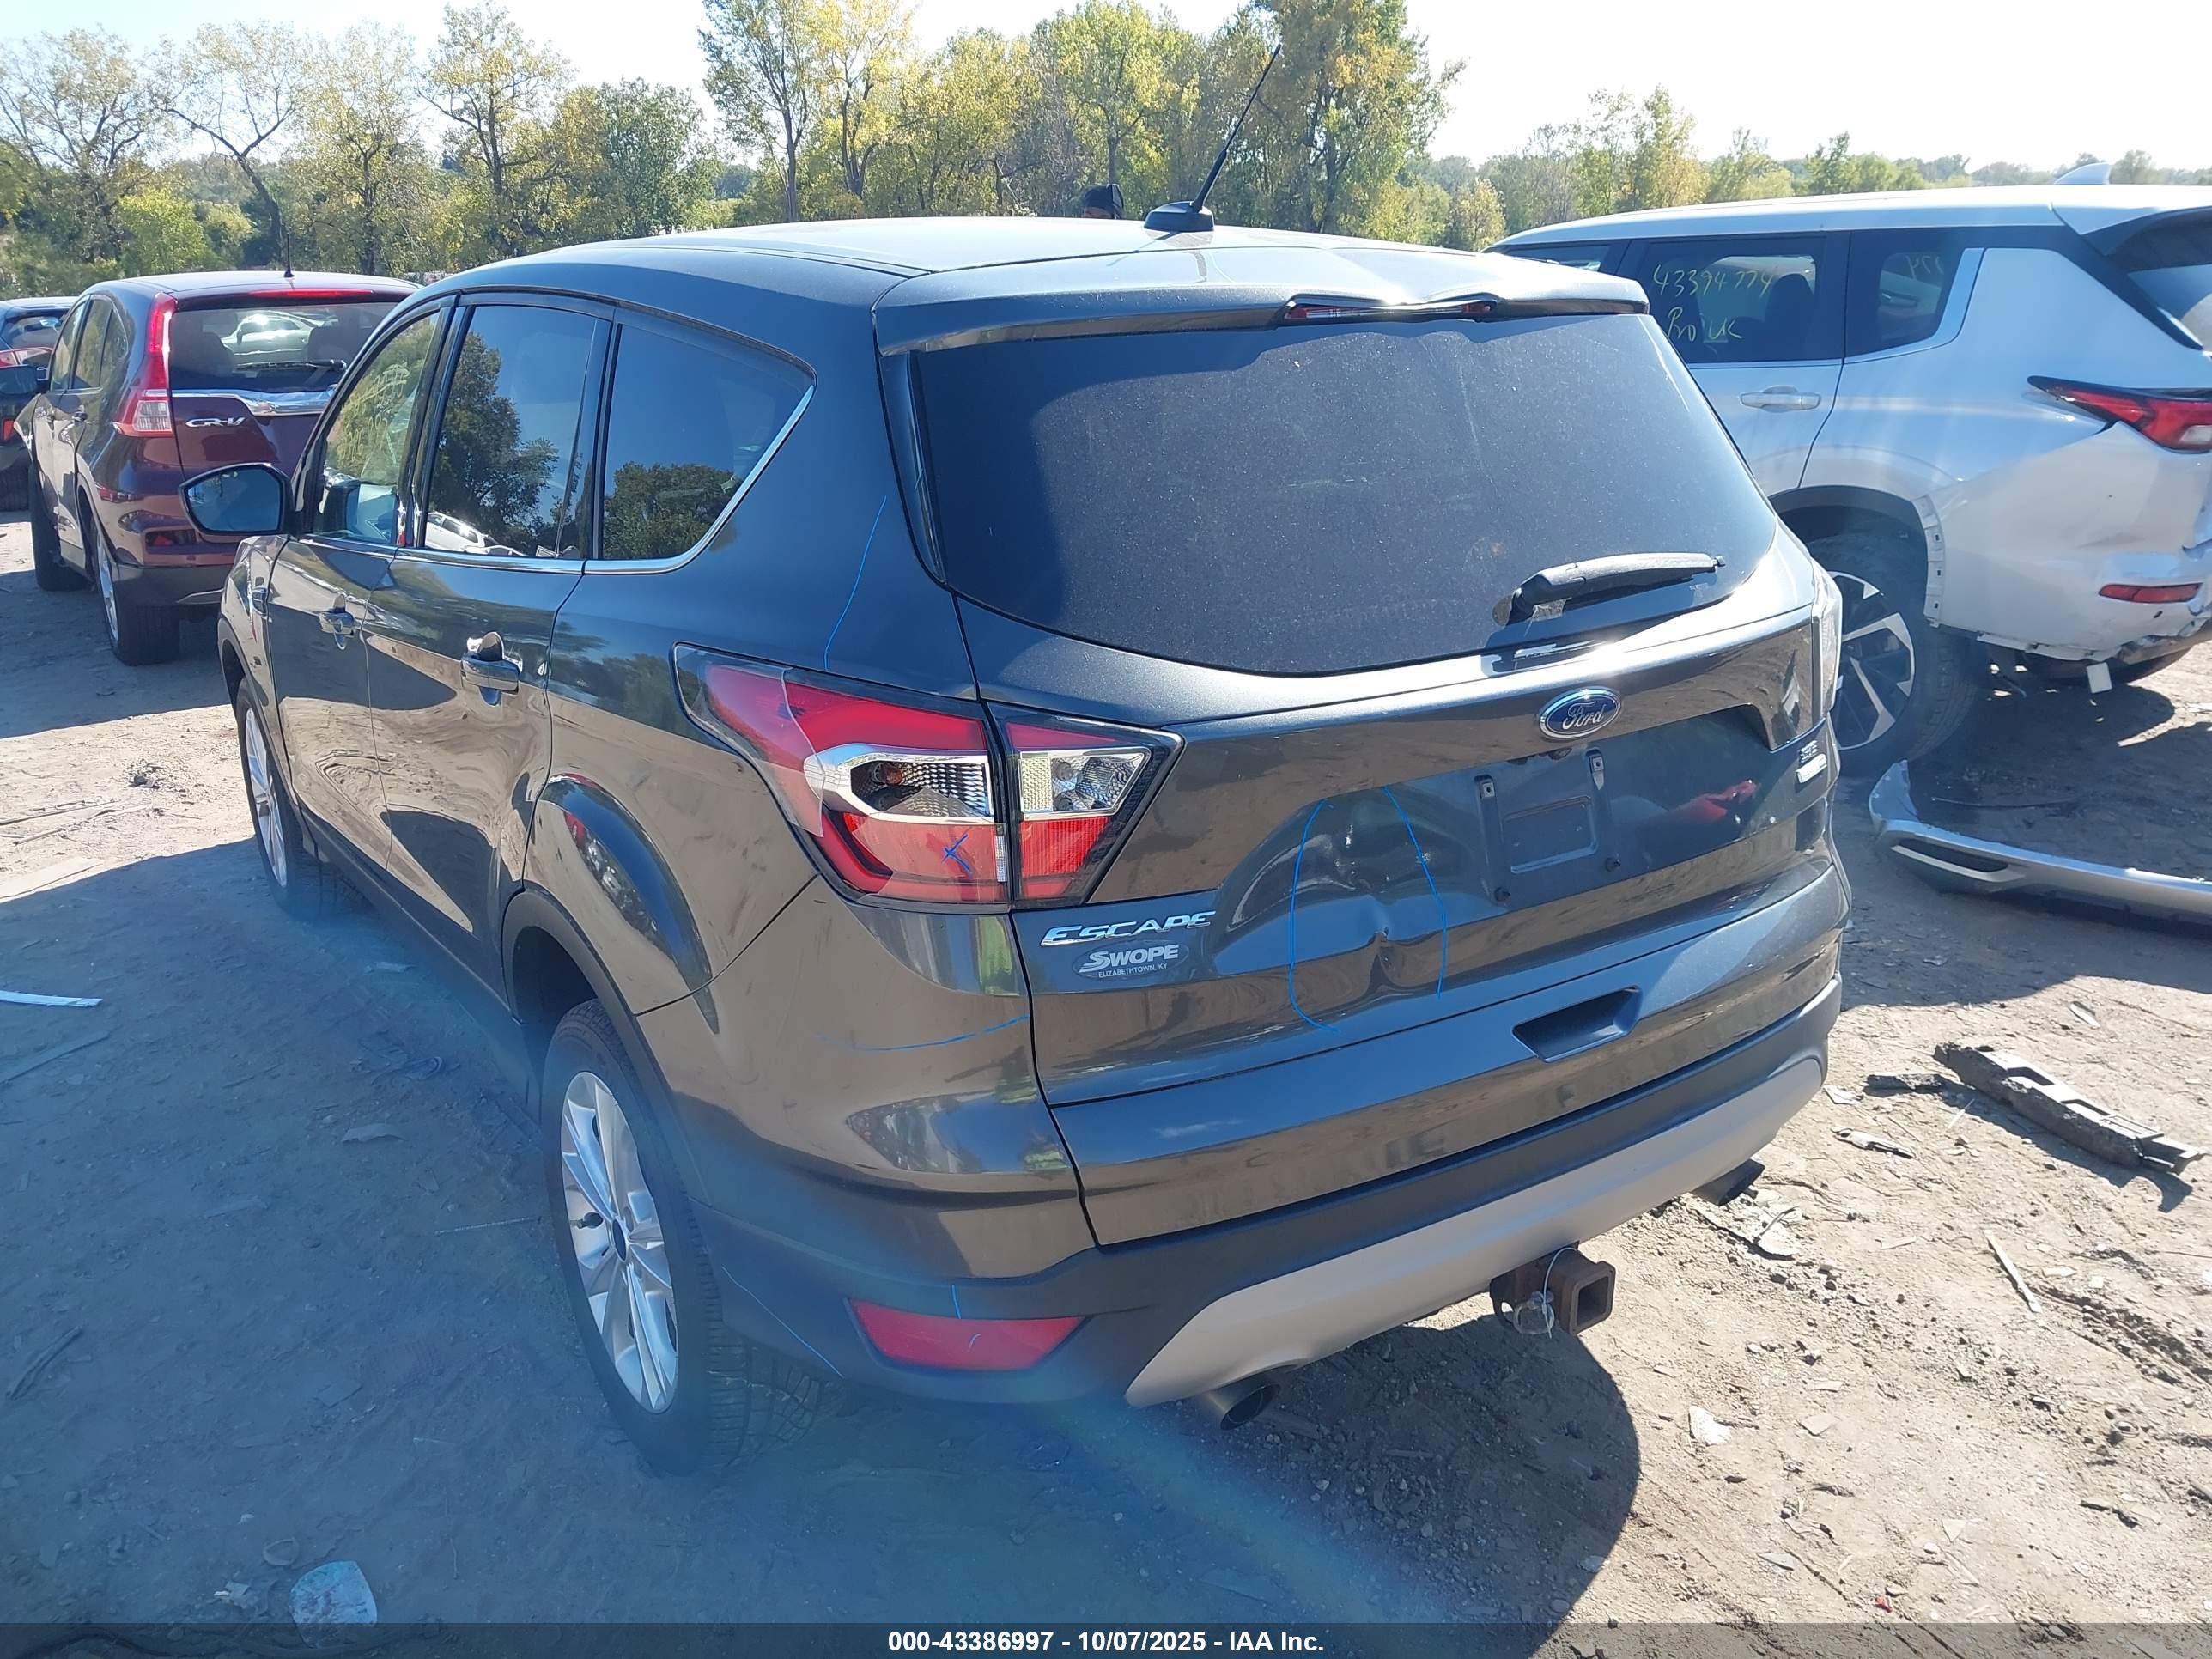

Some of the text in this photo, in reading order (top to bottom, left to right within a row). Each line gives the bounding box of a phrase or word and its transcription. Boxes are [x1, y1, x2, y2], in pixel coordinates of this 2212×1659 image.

[185, 417, 246, 428] CR-V
[1562, 700, 1607, 730] Ford
[1040, 910, 1217, 946] ESCAPE
[1079, 944, 1180, 974] SWOPE
[1098, 962, 1169, 979] ELIZABETHTOWN, KY
